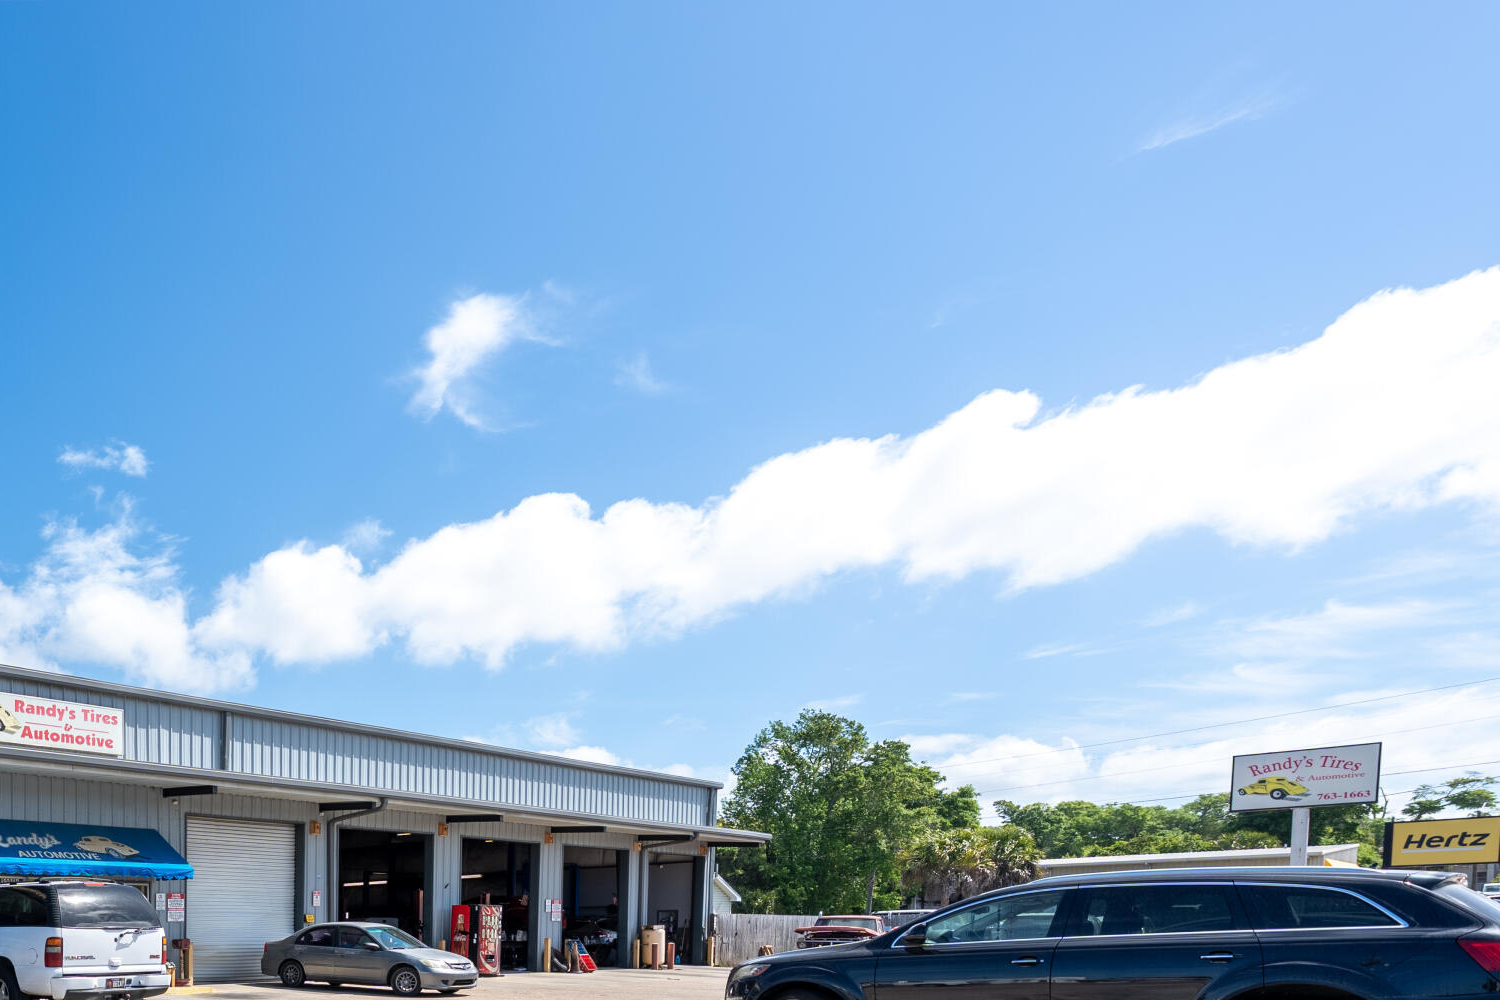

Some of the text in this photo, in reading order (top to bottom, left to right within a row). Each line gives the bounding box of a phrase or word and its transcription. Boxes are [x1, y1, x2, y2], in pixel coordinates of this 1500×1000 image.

[14, 699, 119, 726] Randy's Tires
[20, 725, 114, 749] Automotive
[1248, 755, 1362, 777] Randy's Tires
[1308, 772, 1365, 782] Automotive
[1317, 789, 1371, 801] 763-1663
[1403, 831, 1491, 850] Hertz
[18, 850, 102, 860] AUTOMOTIVE
